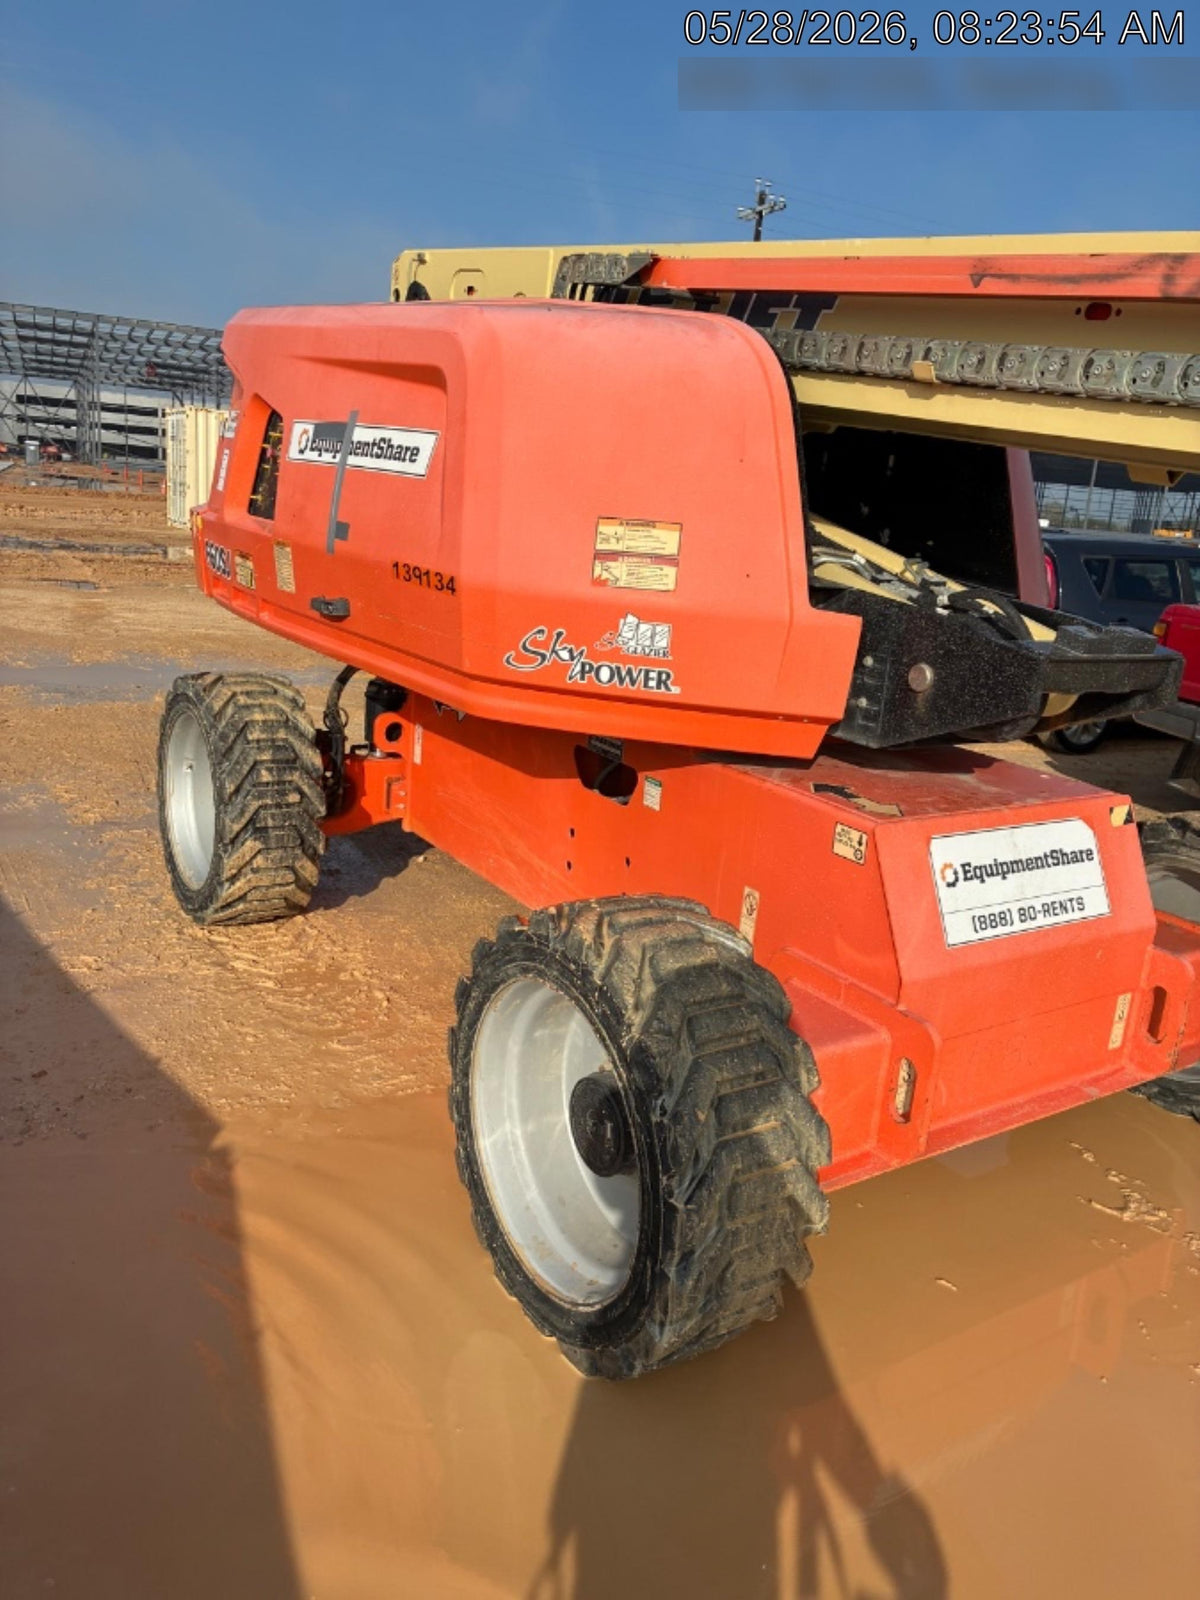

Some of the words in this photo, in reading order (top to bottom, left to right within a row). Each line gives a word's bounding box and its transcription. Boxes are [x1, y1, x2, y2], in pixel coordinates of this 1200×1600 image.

[392, 561, 457, 596] 139134
[578, 660, 674, 692] POWER
[960, 848, 1095, 884] EquipmentShare
[972, 911, 1014, 933] (888)
[1018, 896, 1086, 924] 80-RENTS
